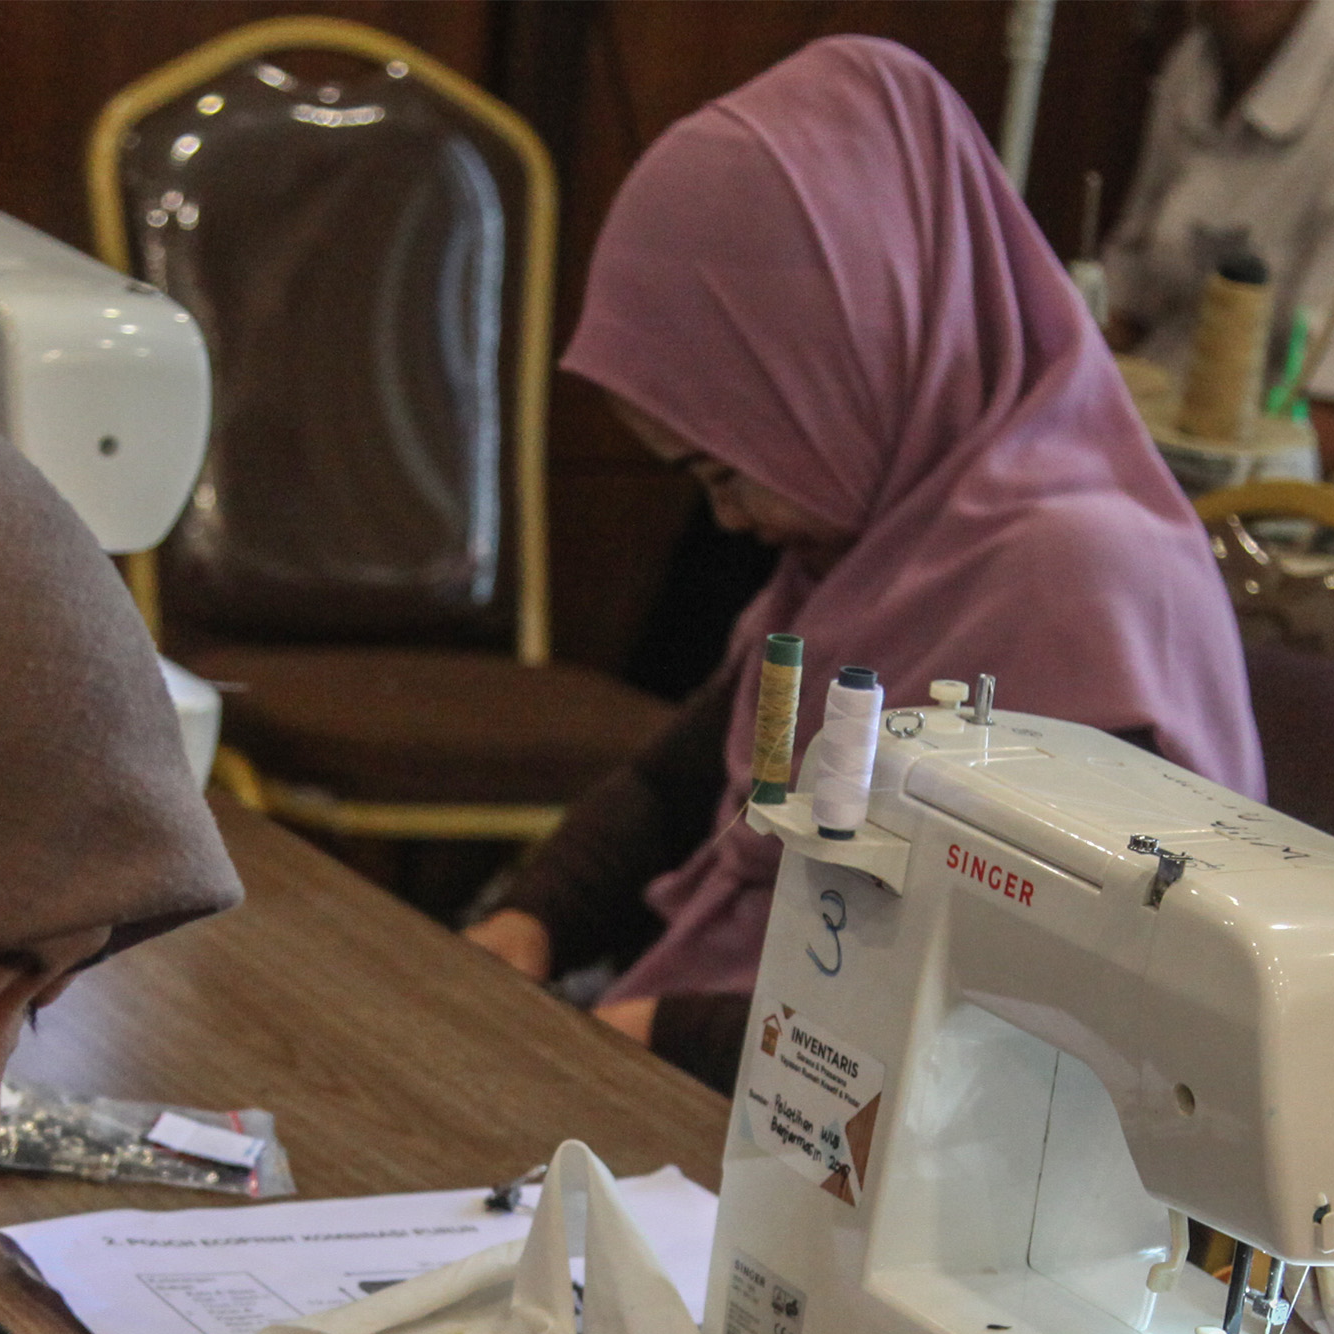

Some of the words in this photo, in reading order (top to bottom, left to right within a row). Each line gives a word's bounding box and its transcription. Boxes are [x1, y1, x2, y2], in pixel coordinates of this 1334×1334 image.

[946, 843, 1036, 907] SINGER
[805, 888, 847, 977] 3
[791, 1027, 859, 1078] INVENTARIS
[734, 1259, 766, 1288] SINGER
